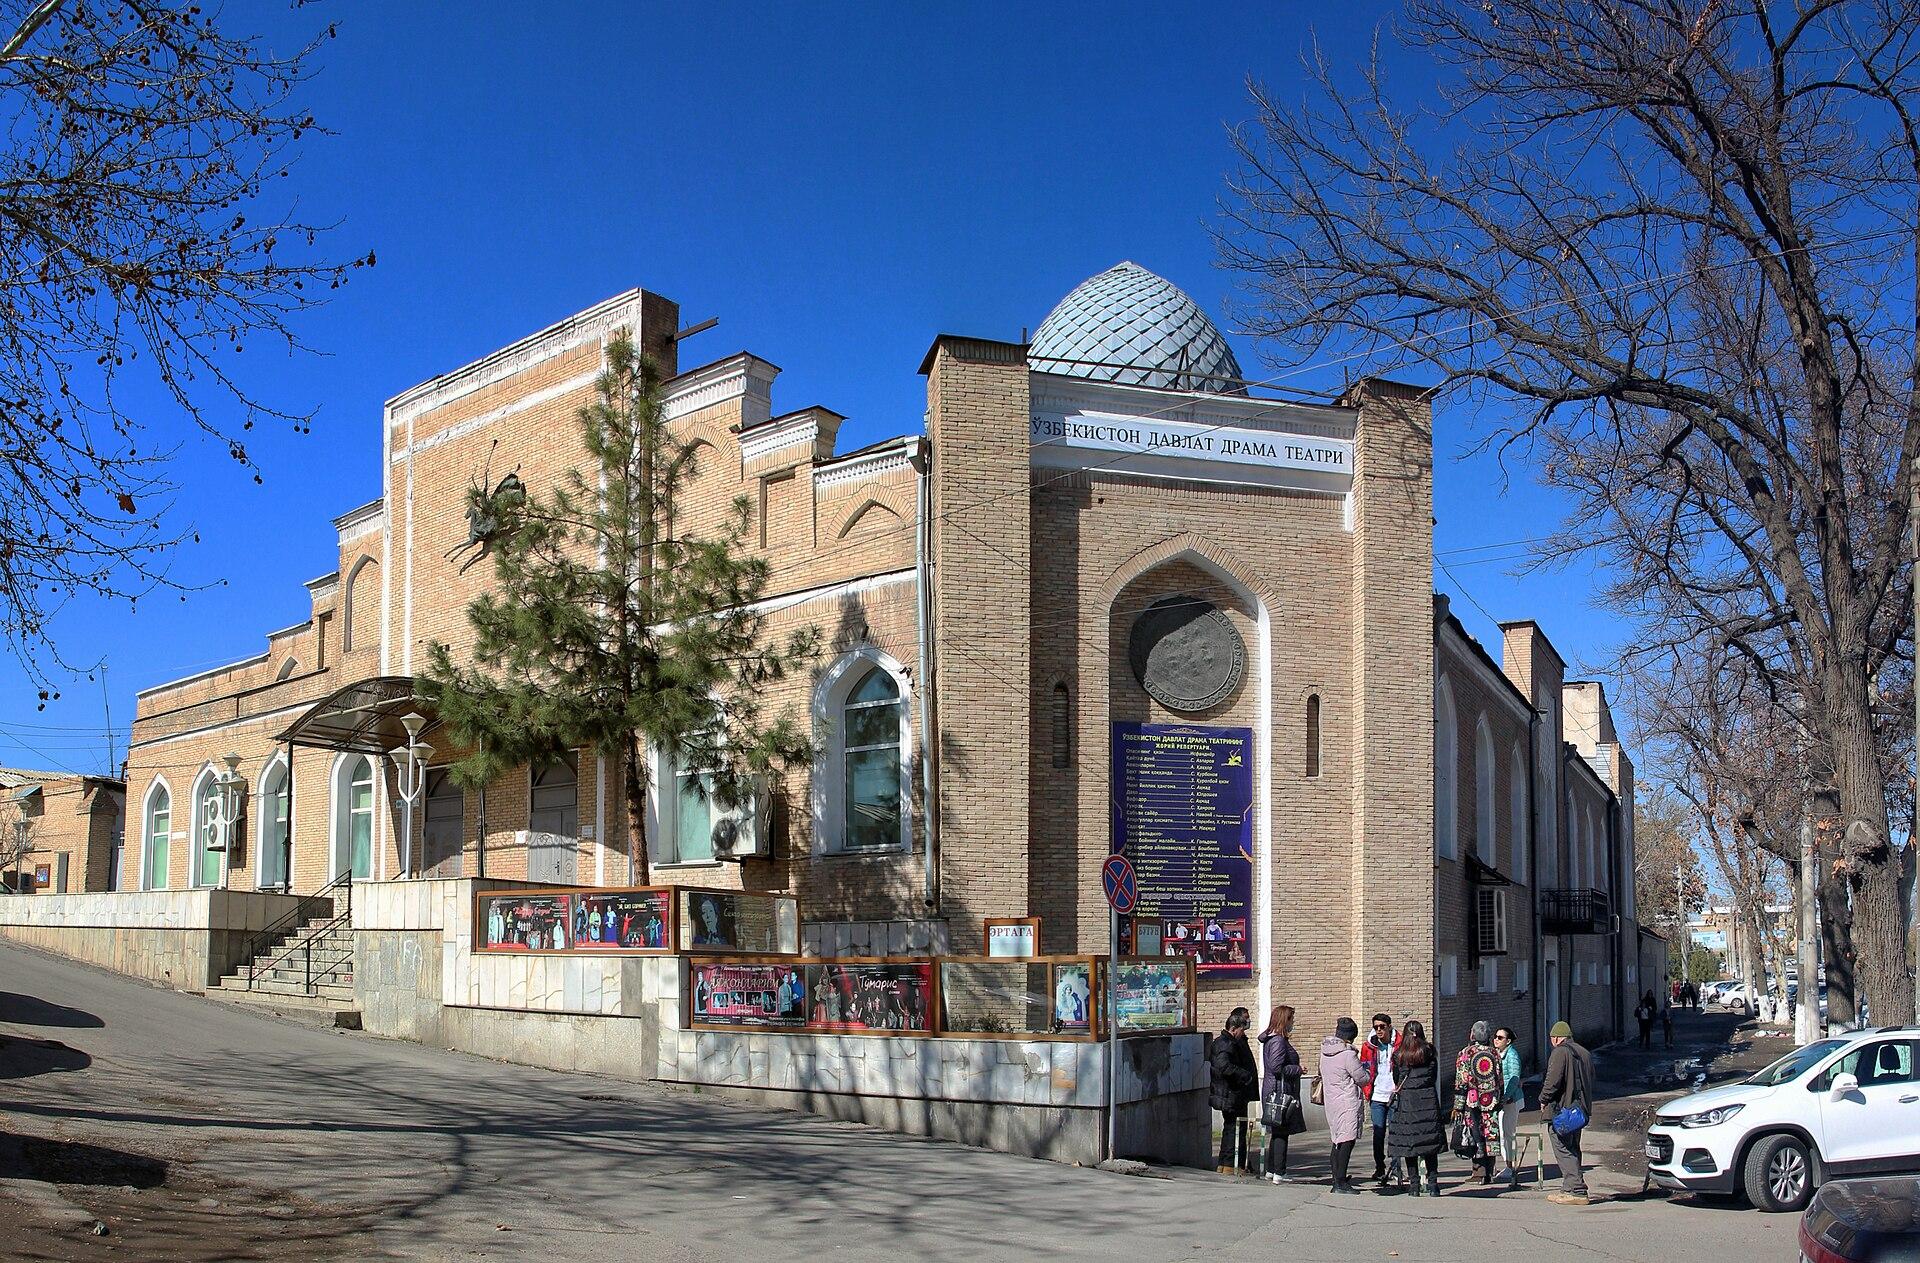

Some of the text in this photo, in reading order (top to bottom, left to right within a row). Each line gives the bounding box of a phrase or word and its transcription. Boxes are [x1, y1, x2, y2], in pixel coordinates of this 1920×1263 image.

[1032, 417, 1343, 464] ЎЗБЕКИСТОН ДАВЛАТ ДРАМА ТЕАТРИ
[990, 927, 1033, 937] ЭРТАГА
